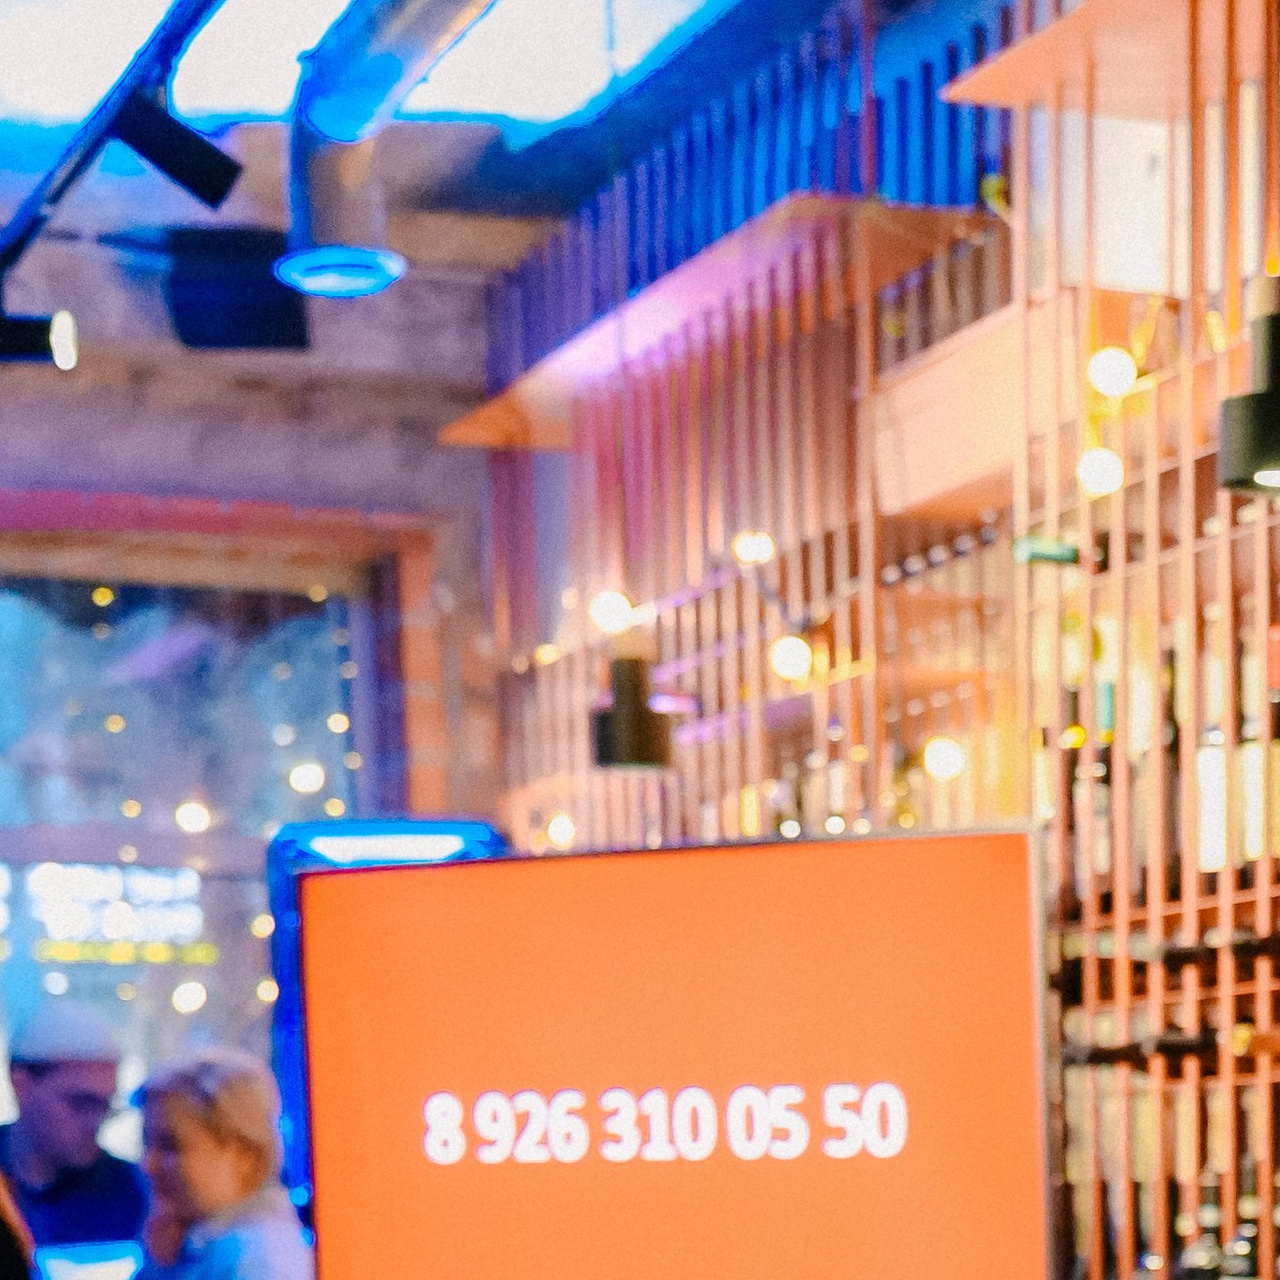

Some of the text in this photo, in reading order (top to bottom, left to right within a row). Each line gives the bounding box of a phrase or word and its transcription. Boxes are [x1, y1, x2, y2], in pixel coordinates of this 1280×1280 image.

[423, 1081, 908, 1165] 8 926 310 05 50
